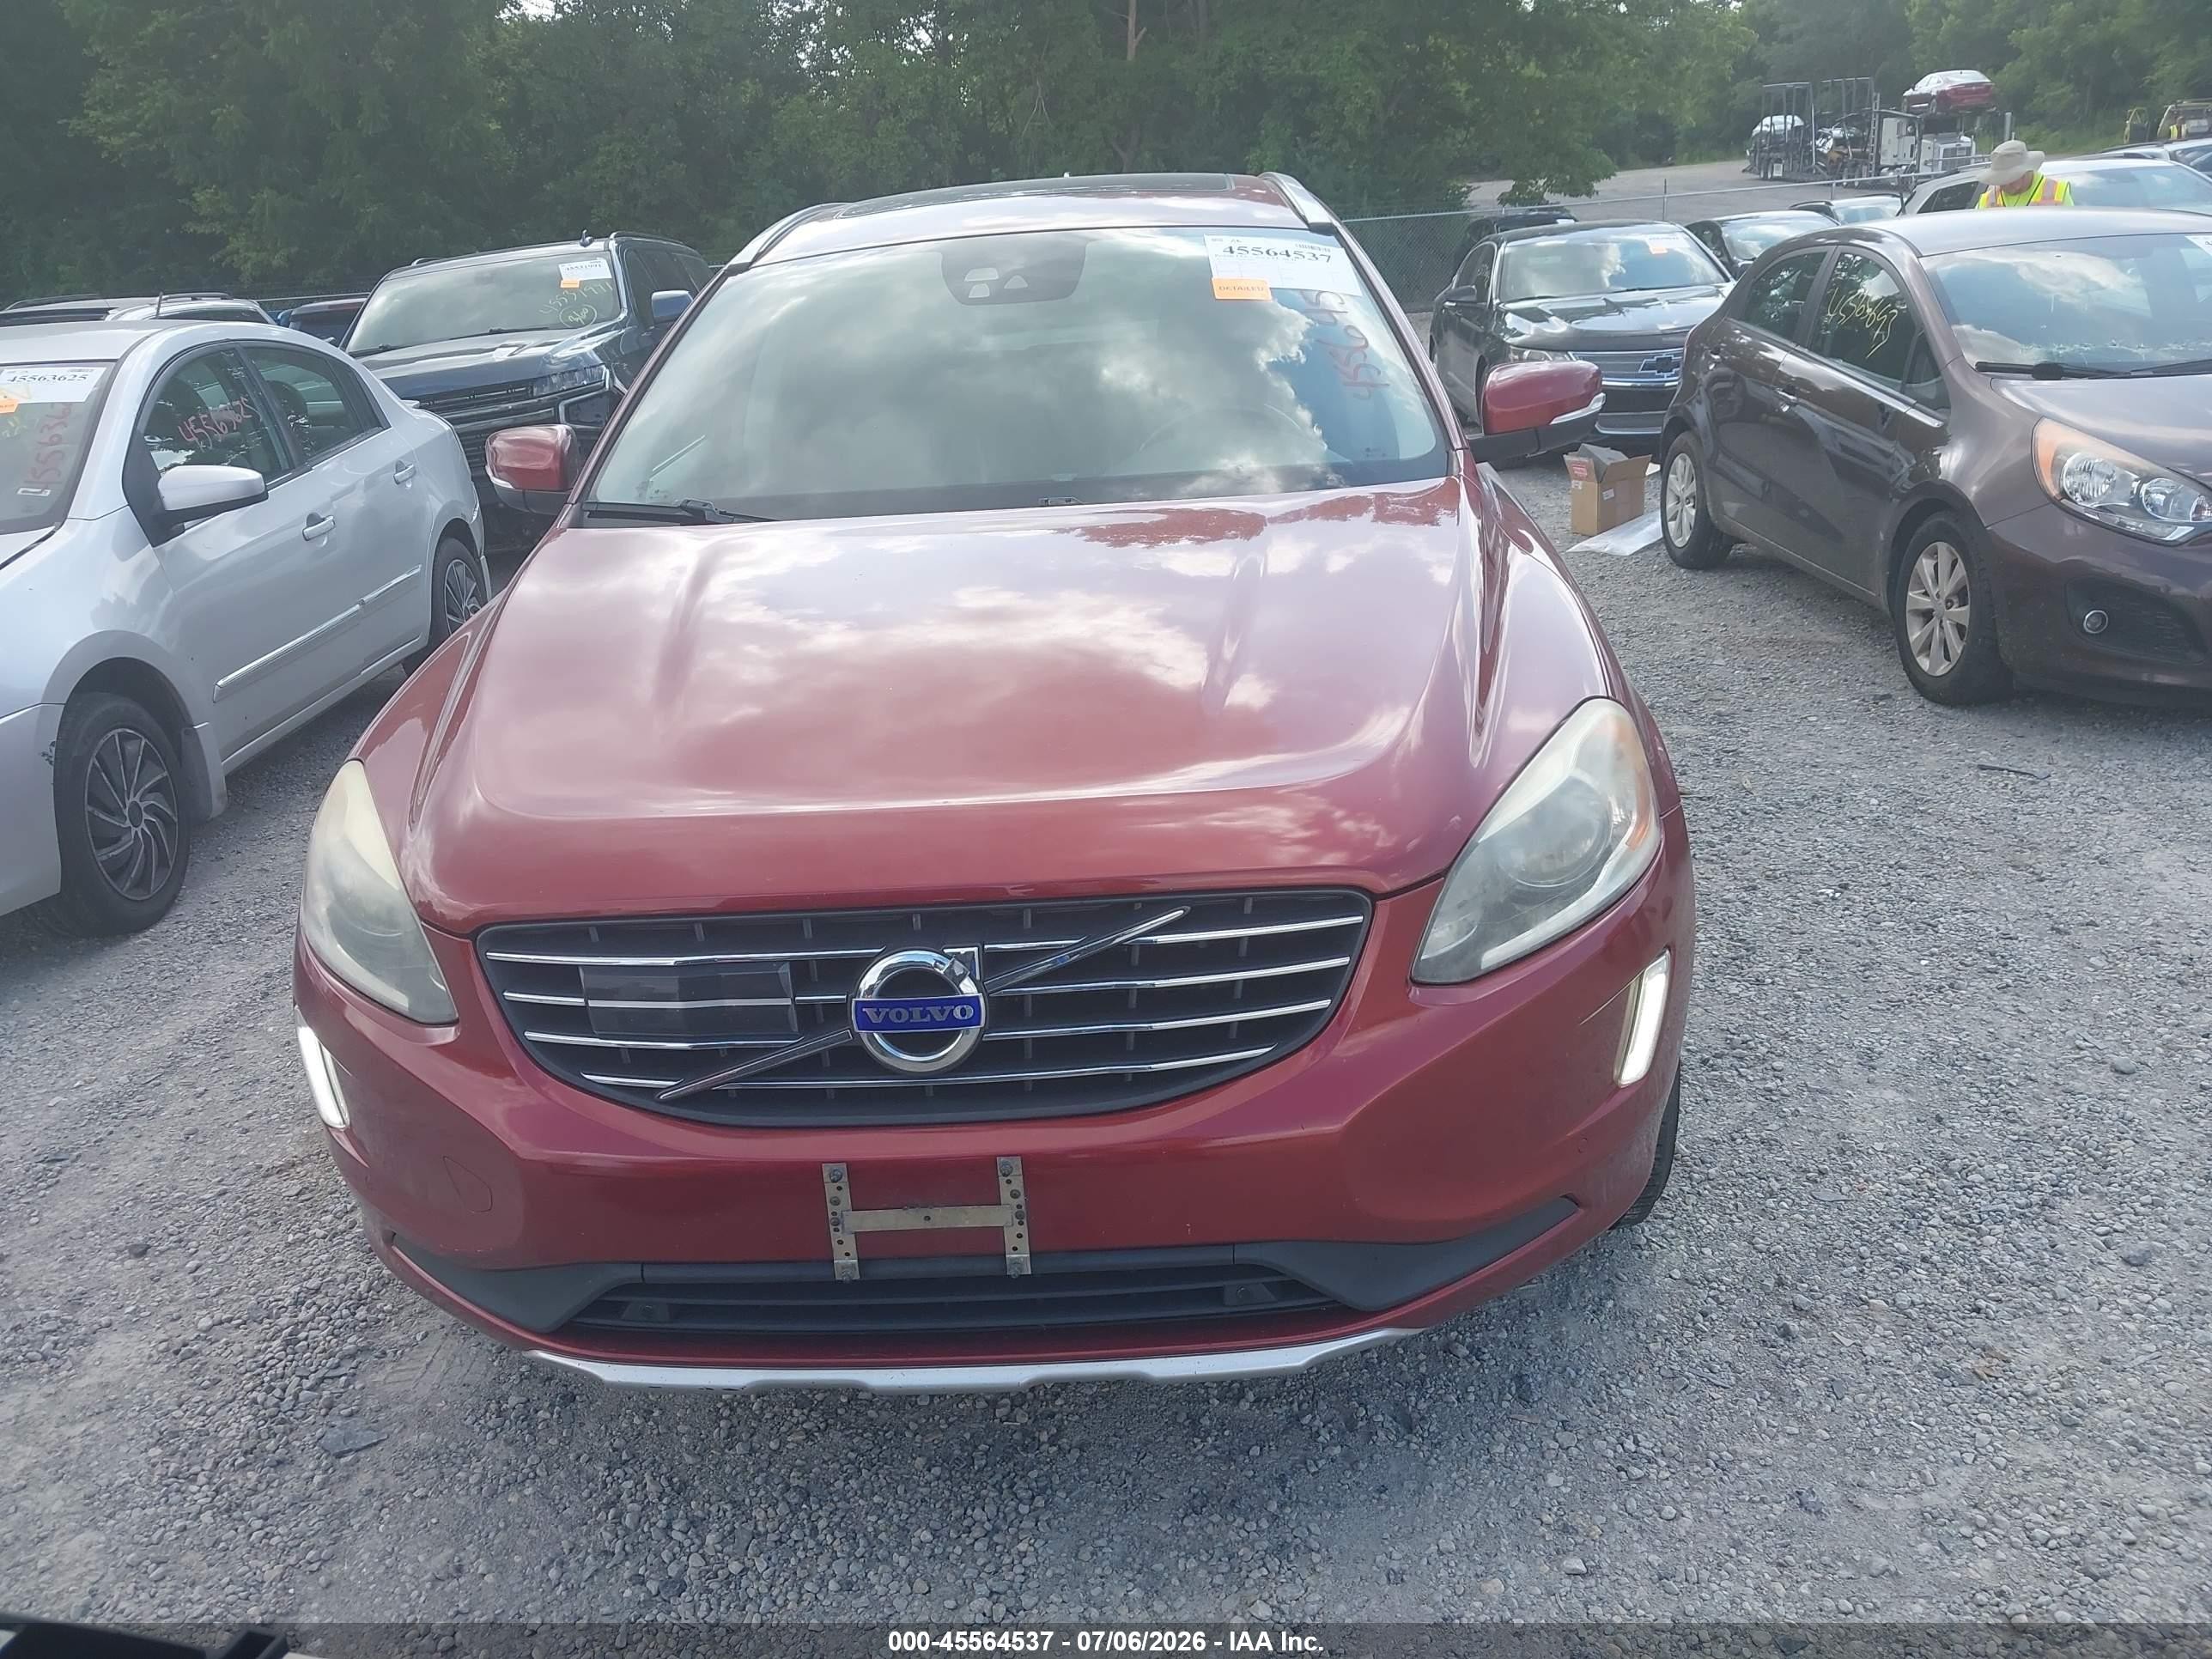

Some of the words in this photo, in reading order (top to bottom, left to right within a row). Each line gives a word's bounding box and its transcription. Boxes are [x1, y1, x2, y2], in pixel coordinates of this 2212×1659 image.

[1222, 246, 1332, 264] 45564537
[7, 374, 88, 383] 45563625
[862, 1005, 975, 1024] VOLVO
